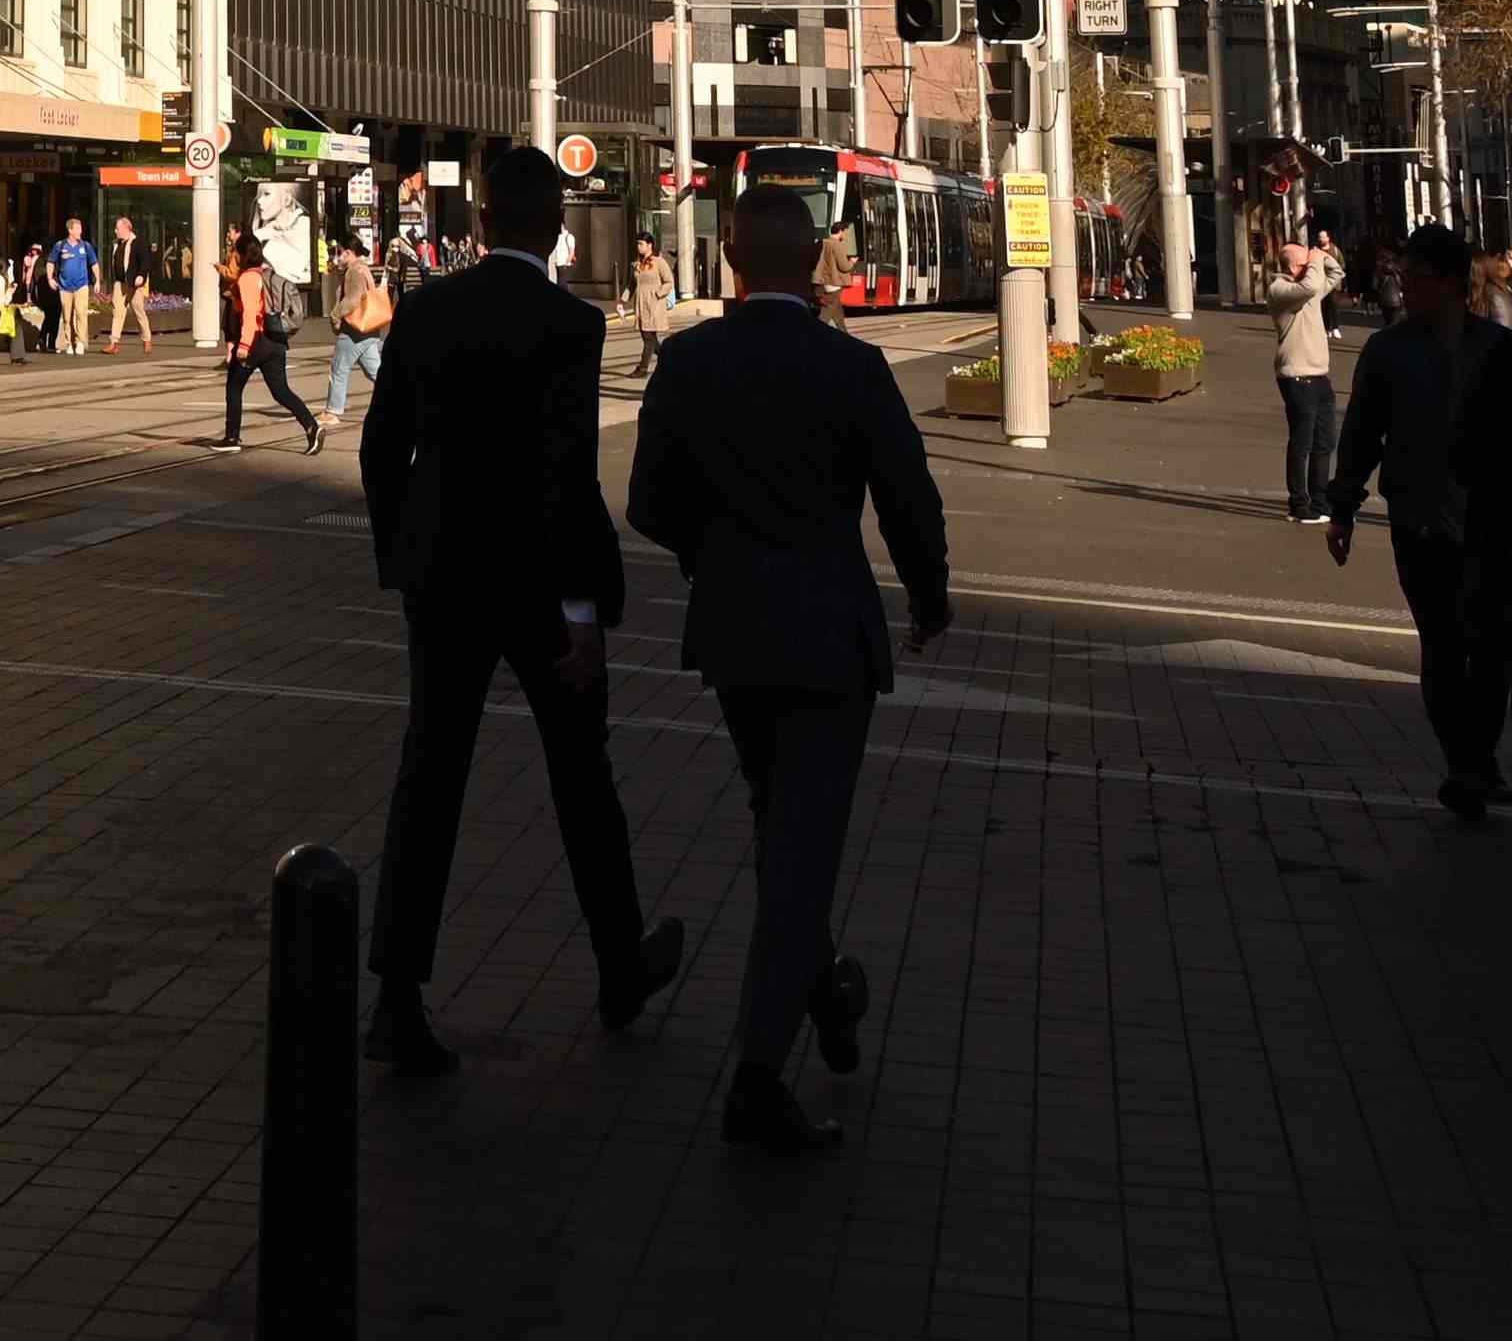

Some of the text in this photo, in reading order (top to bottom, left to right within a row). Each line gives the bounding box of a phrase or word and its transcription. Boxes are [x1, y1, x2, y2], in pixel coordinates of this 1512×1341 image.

[1084, 0, 1118, 12] RIGHT
[1085, 15, 1118, 27] TURN
[192, 146, 210, 161] 20
[568, 145, 586, 169] T
[136, 171, 180, 182] Town Hall
[1007, 186, 1045, 195] CAUTION
[1010, 243, 1049, 251] CAUTION
